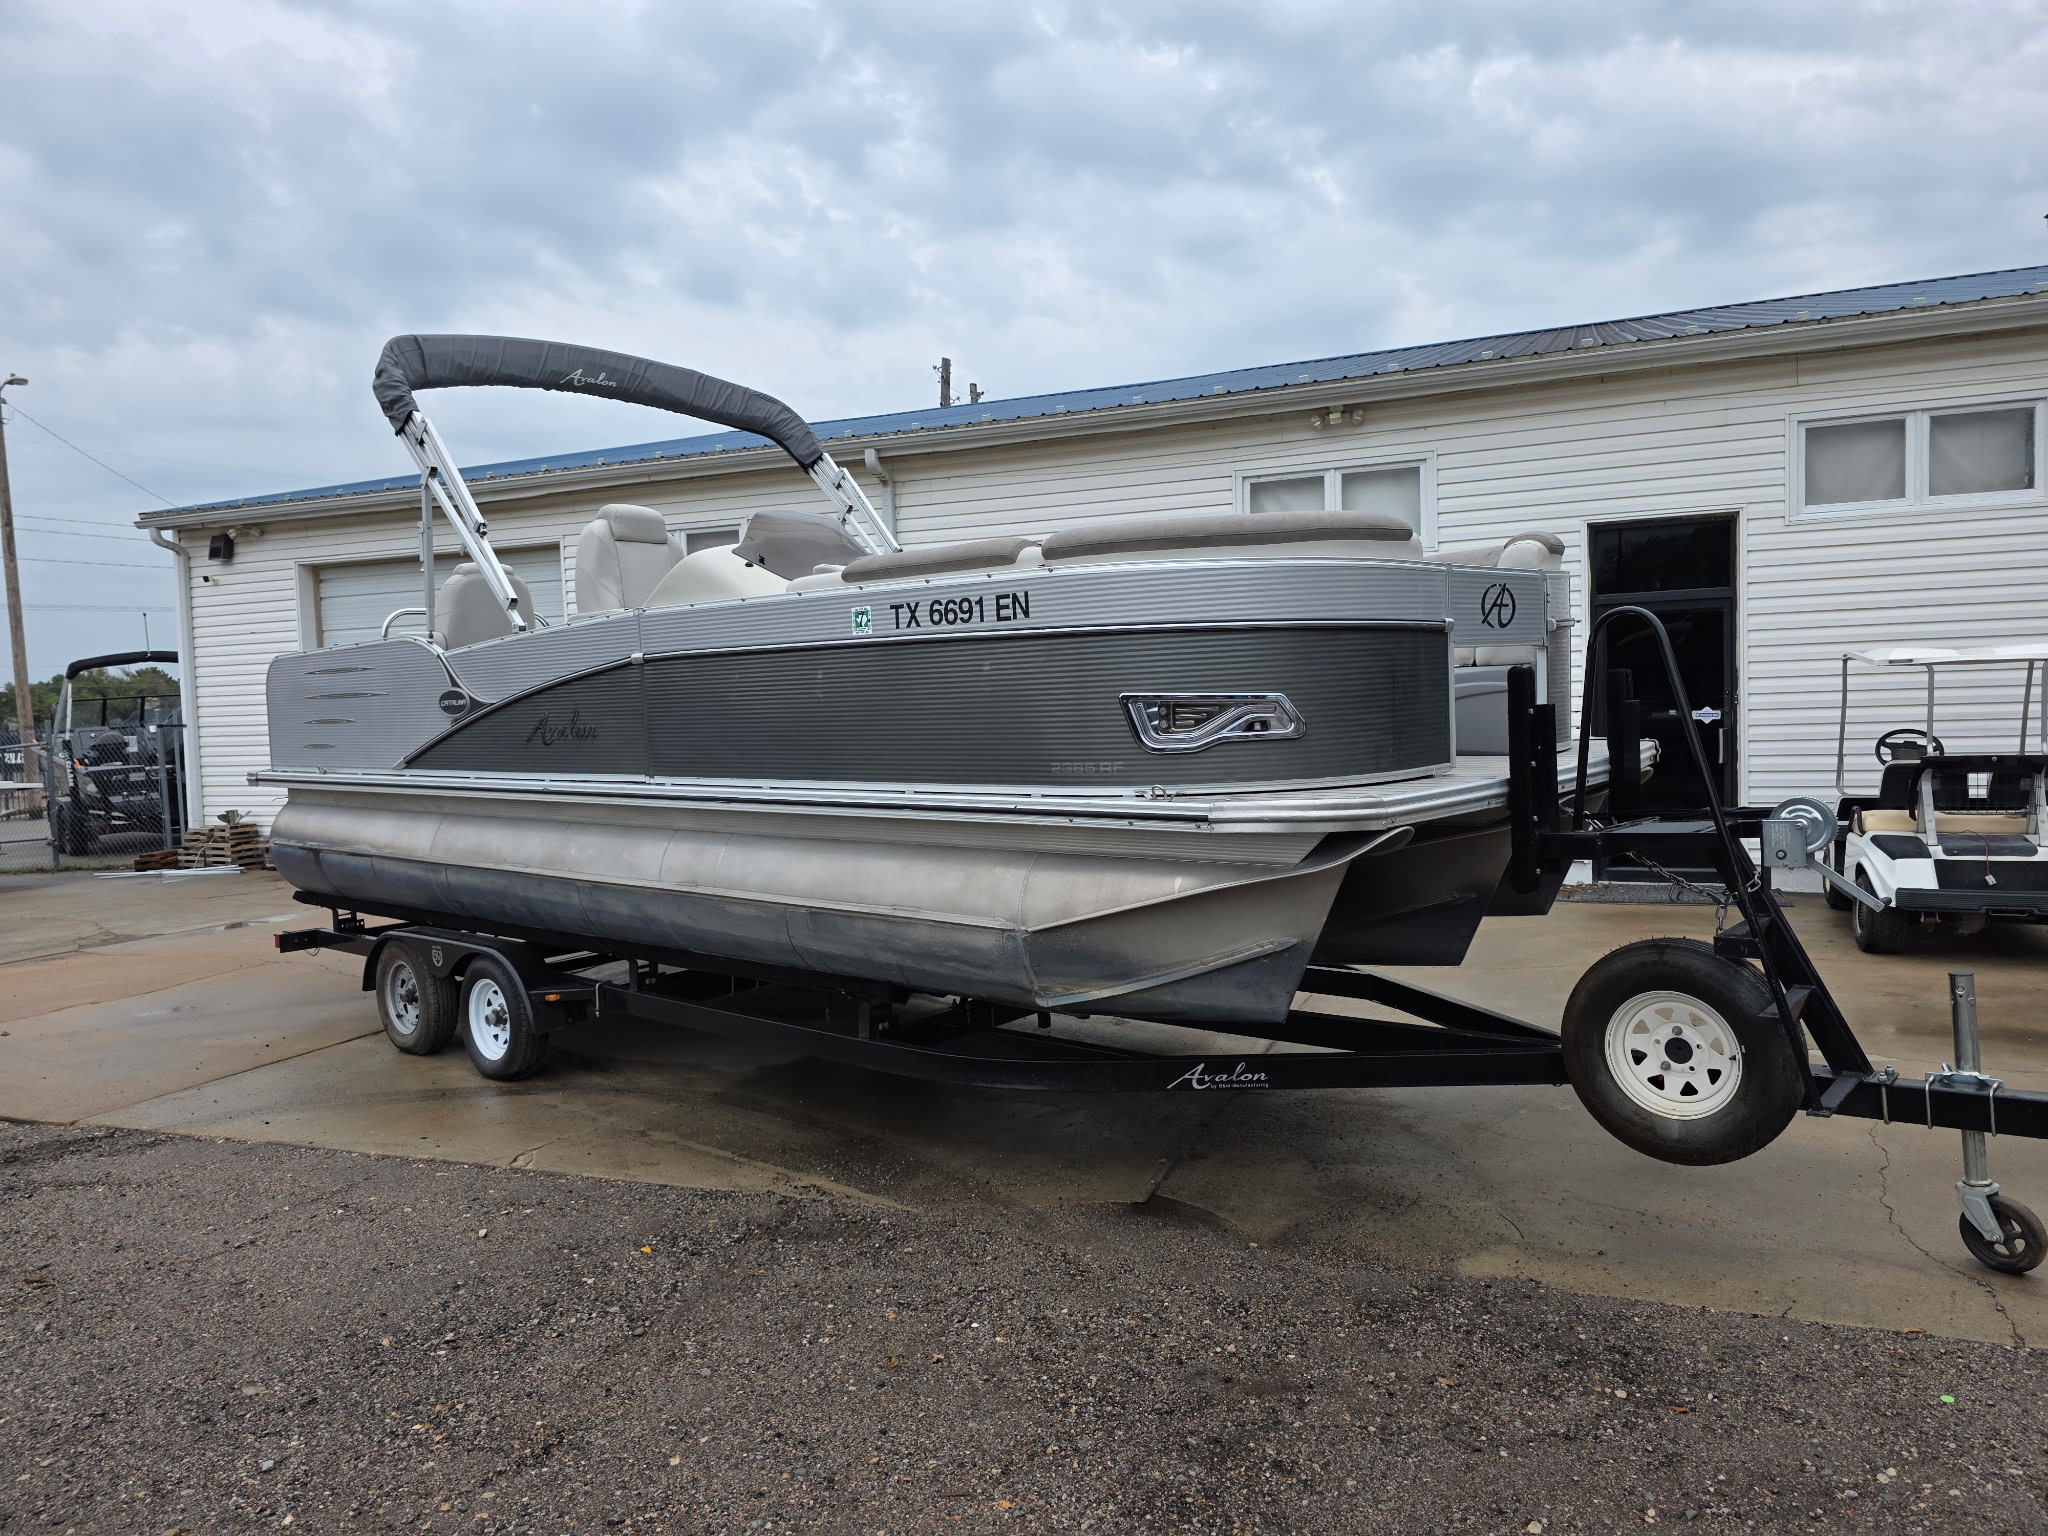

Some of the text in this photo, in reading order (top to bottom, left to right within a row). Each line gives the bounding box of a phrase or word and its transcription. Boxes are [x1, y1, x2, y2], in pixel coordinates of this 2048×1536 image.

[560, 368, 618, 387] Avalon
[889, 590, 1030, 630] TX 6691 EN
[1166, 1062, 1269, 1090] Avalon
